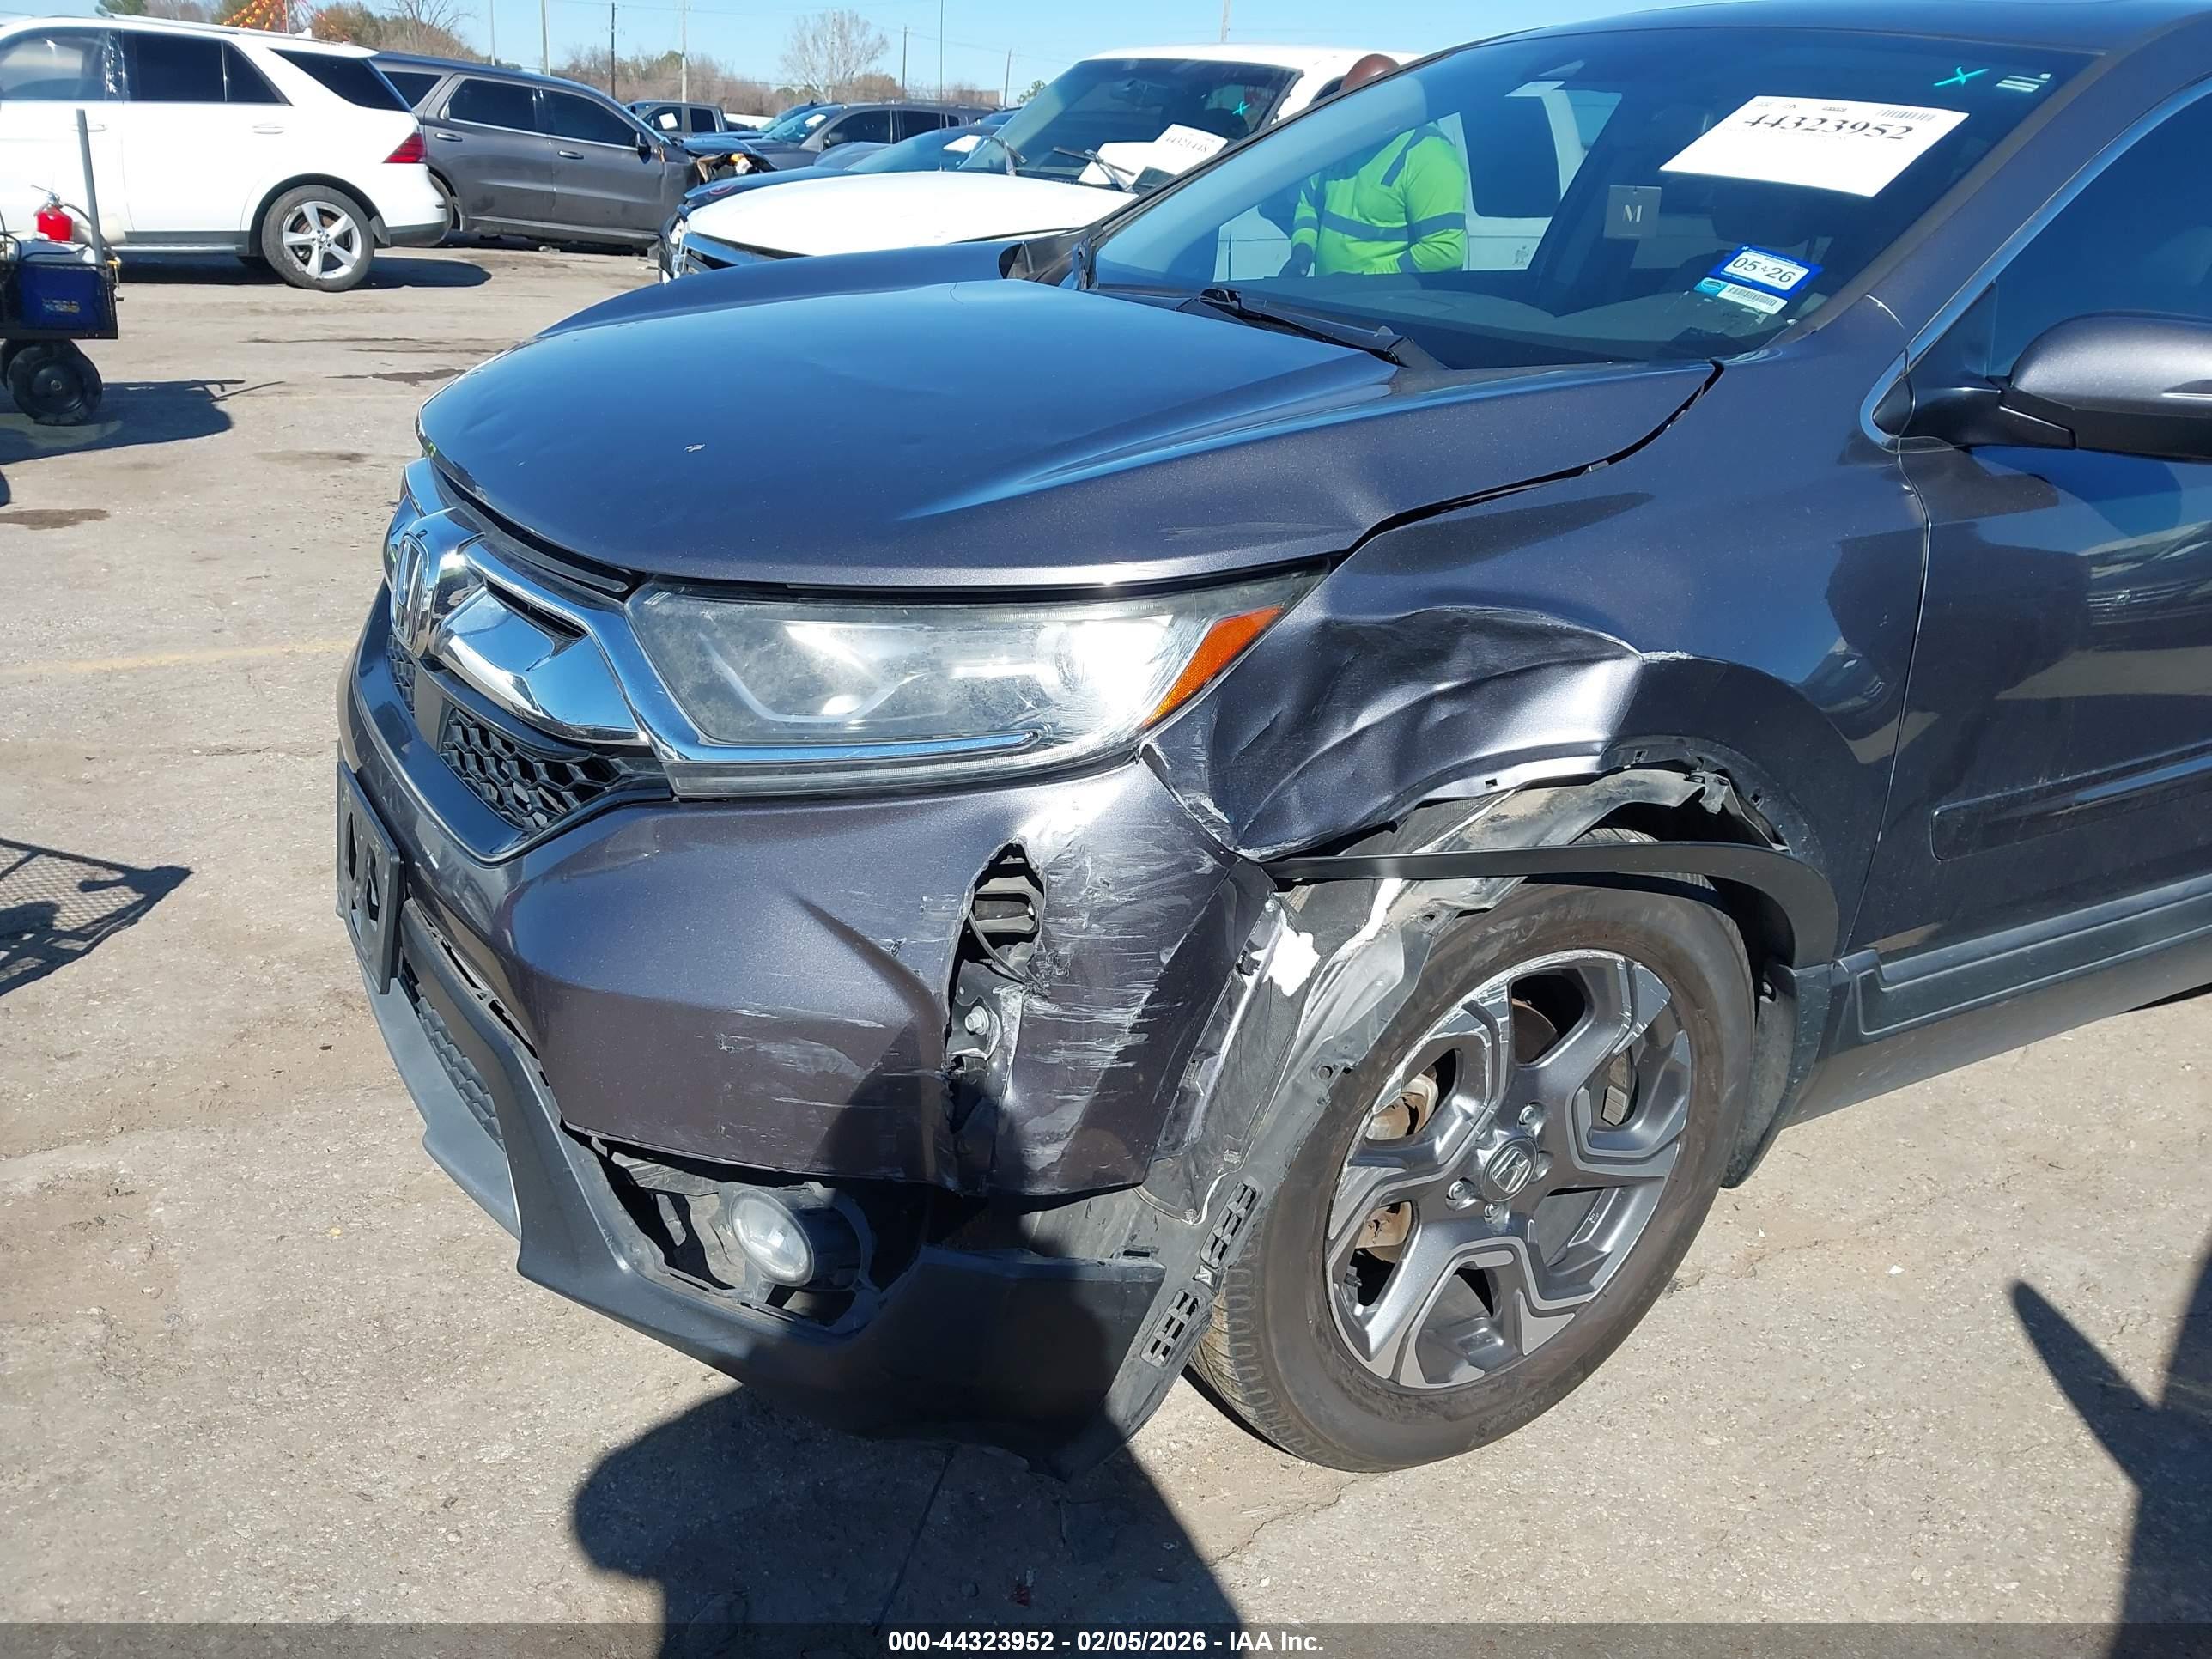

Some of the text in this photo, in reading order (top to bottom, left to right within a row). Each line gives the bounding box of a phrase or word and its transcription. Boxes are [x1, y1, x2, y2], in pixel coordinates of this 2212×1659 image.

[1744, 113, 1914, 140] 44323952
[1732, 257, 1761, 272] 05
[1765, 266, 1796, 283] 26
